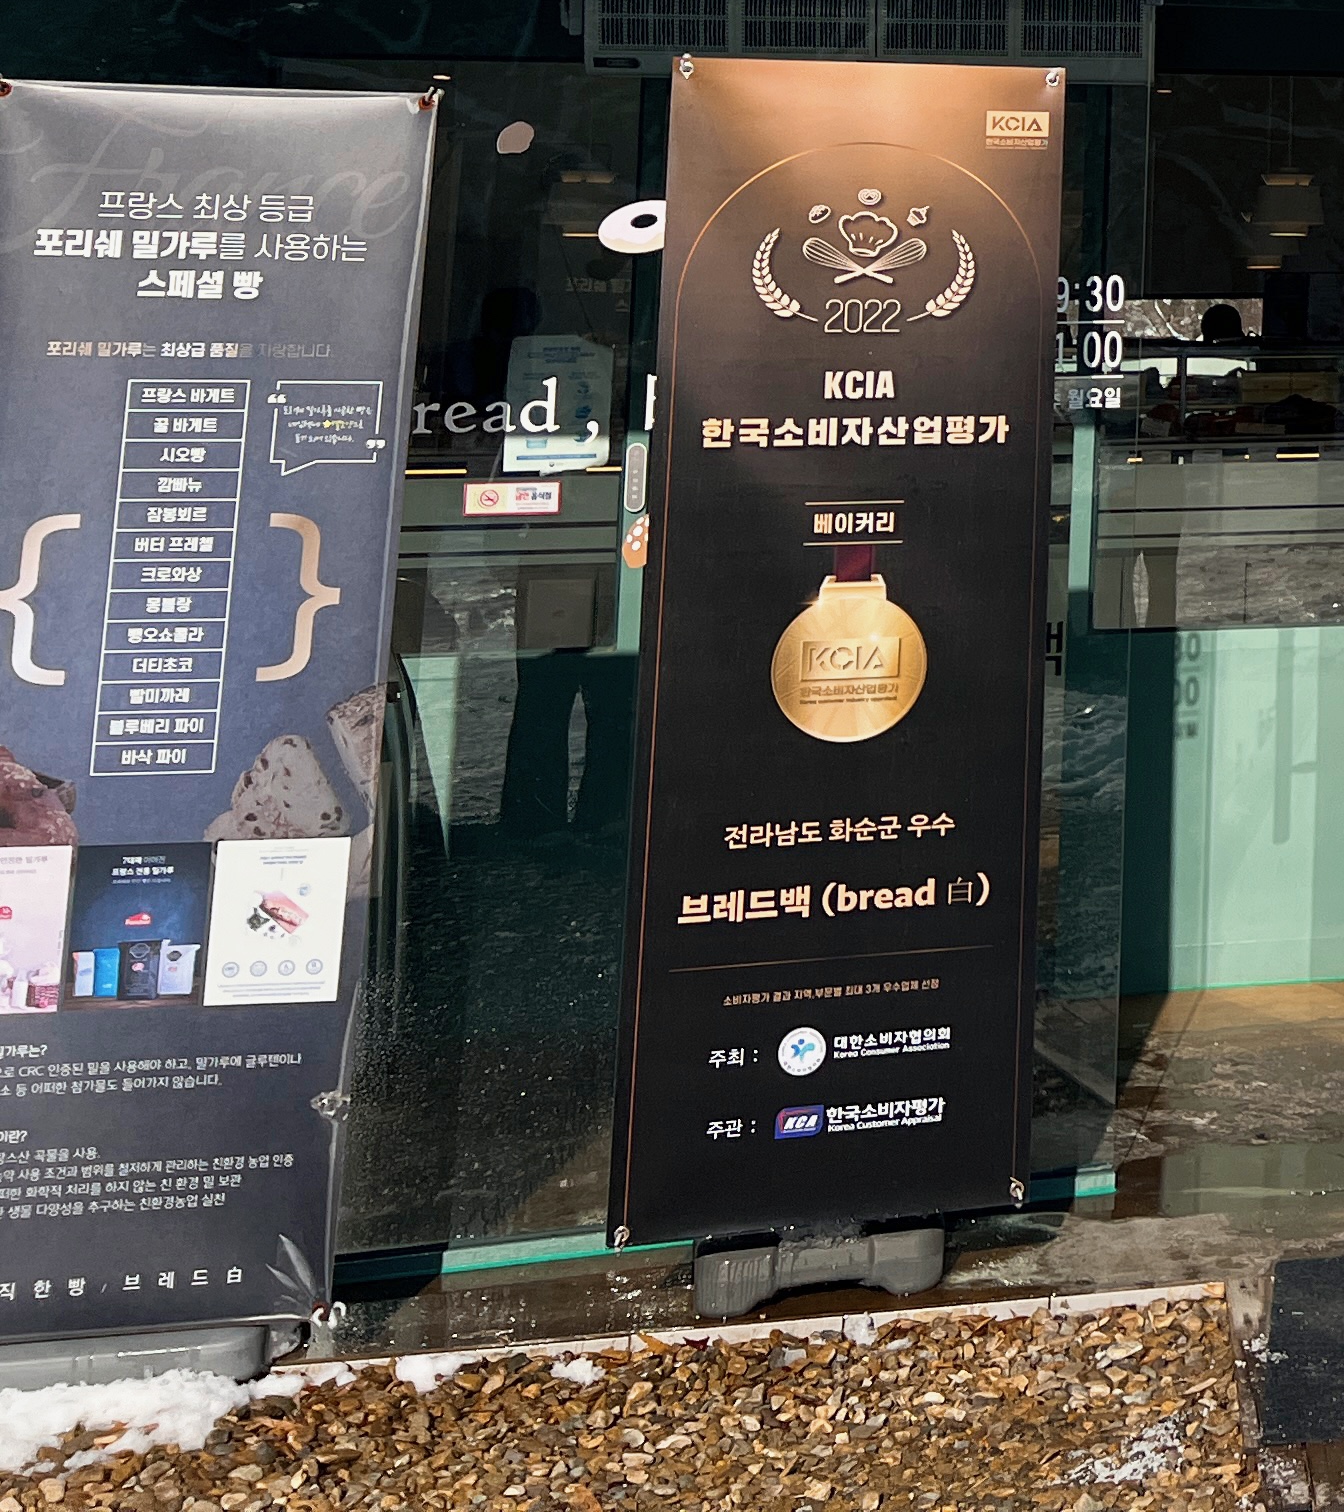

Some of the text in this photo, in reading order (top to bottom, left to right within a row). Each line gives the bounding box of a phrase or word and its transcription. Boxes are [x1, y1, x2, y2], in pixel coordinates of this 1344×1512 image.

[992, 116, 1043, 132] KCIA
[98, 191, 315, 223] 프랑스 최상 등급
[33, 228, 368, 262] 포리쉐 밀가루를 사용하는
[137, 270, 264, 300] 스페셜 빵
[824, 299, 901, 334] 2022
[46, 341, 92, 357] 포리쉐
[97, 341, 156, 358] 밀가루는
[160, 342, 206, 358] 최상급
[209, 342, 253, 358] 품질을
[824, 370, 895, 400] KCIA
[141, 388, 236, 404] 프랑스 바게트
[172, 417, 219, 433] 바게트
[702, 415, 1010, 450] 한국소비자산업평가
[160, 447, 207, 463] 시오빵
[812, 511, 895, 536] 베이커리
[134, 536, 166, 553] 버터
[141, 566, 203, 583] 크로와상
[132, 656, 193, 674] 더티초코
[808, 646, 886, 672] KCIA
[109, 717, 205, 736] 블루베리 파이
[121, 748, 187, 765] 바삭 파이
[723, 812, 956, 851] 전라남도 화순군 우수
[677, 872, 991, 926] 브레드백 (bread 白)
[722, 994, 771, 1007] 소비자평가
[772, 991, 791, 1003] 결과
[845, 984, 864, 996] 최대
[865, 982, 881, 994] 3개
[883, 980, 919, 993] 우수업체
[921, 978, 940, 989] 선정
[833, 1026, 951, 1051] 대한소비자협의회
[708, 1048, 745, 1069] 주최
[833, 1042, 950, 1059] Korea Consumer Association
[18, 1065, 45, 1078] CRC
[48, 1063, 84, 1078] 인증된
[114, 1058, 162, 1074] 사용해야
[196, 1055, 242, 1070] 밀가루에
[246, 1052, 302, 1069] 글루텐이나
[16, 1083, 27, 1097] 등
[31, 1081, 67, 1095] 어떠한
[71, 1079, 118, 1094] 첨가물도
[122, 1076, 169, 1092] 들어가지
[826, 1096, 946, 1124] 한국소비자평가
[706, 1119, 743, 1140] 주관
[784, 1114, 819, 1131] KCA
[827, 1113, 942, 1134] Korea Customer Appraisal
[34, 1147, 70, 1163] 곡물을
[0, 1169, 15, 1183] 약
[17, 1168, 41, 1182] 사용
[44, 1165, 78, 1180] 조건과
[81, 1163, 115, 1178] 범위를
[165, 1158, 209, 1173] 관리하는
[212, 1155, 245, 1171] 친환경
[248, 1155, 269, 1169] 농업
[272, 1153, 294, 1168] 인증
[25, 1184, 62, 1198] 화학적
[65, 1182, 101, 1196] 처리를
[105, 1180, 129, 1193] 하지
[132, 1179, 157, 1193] 않는
[218, 1173, 242, 1188] 보관
[8, 1204, 33, 1219] 생물
[36, 1201, 84, 1217] 다양성을
[88, 1198, 136, 1214] 추구하는
